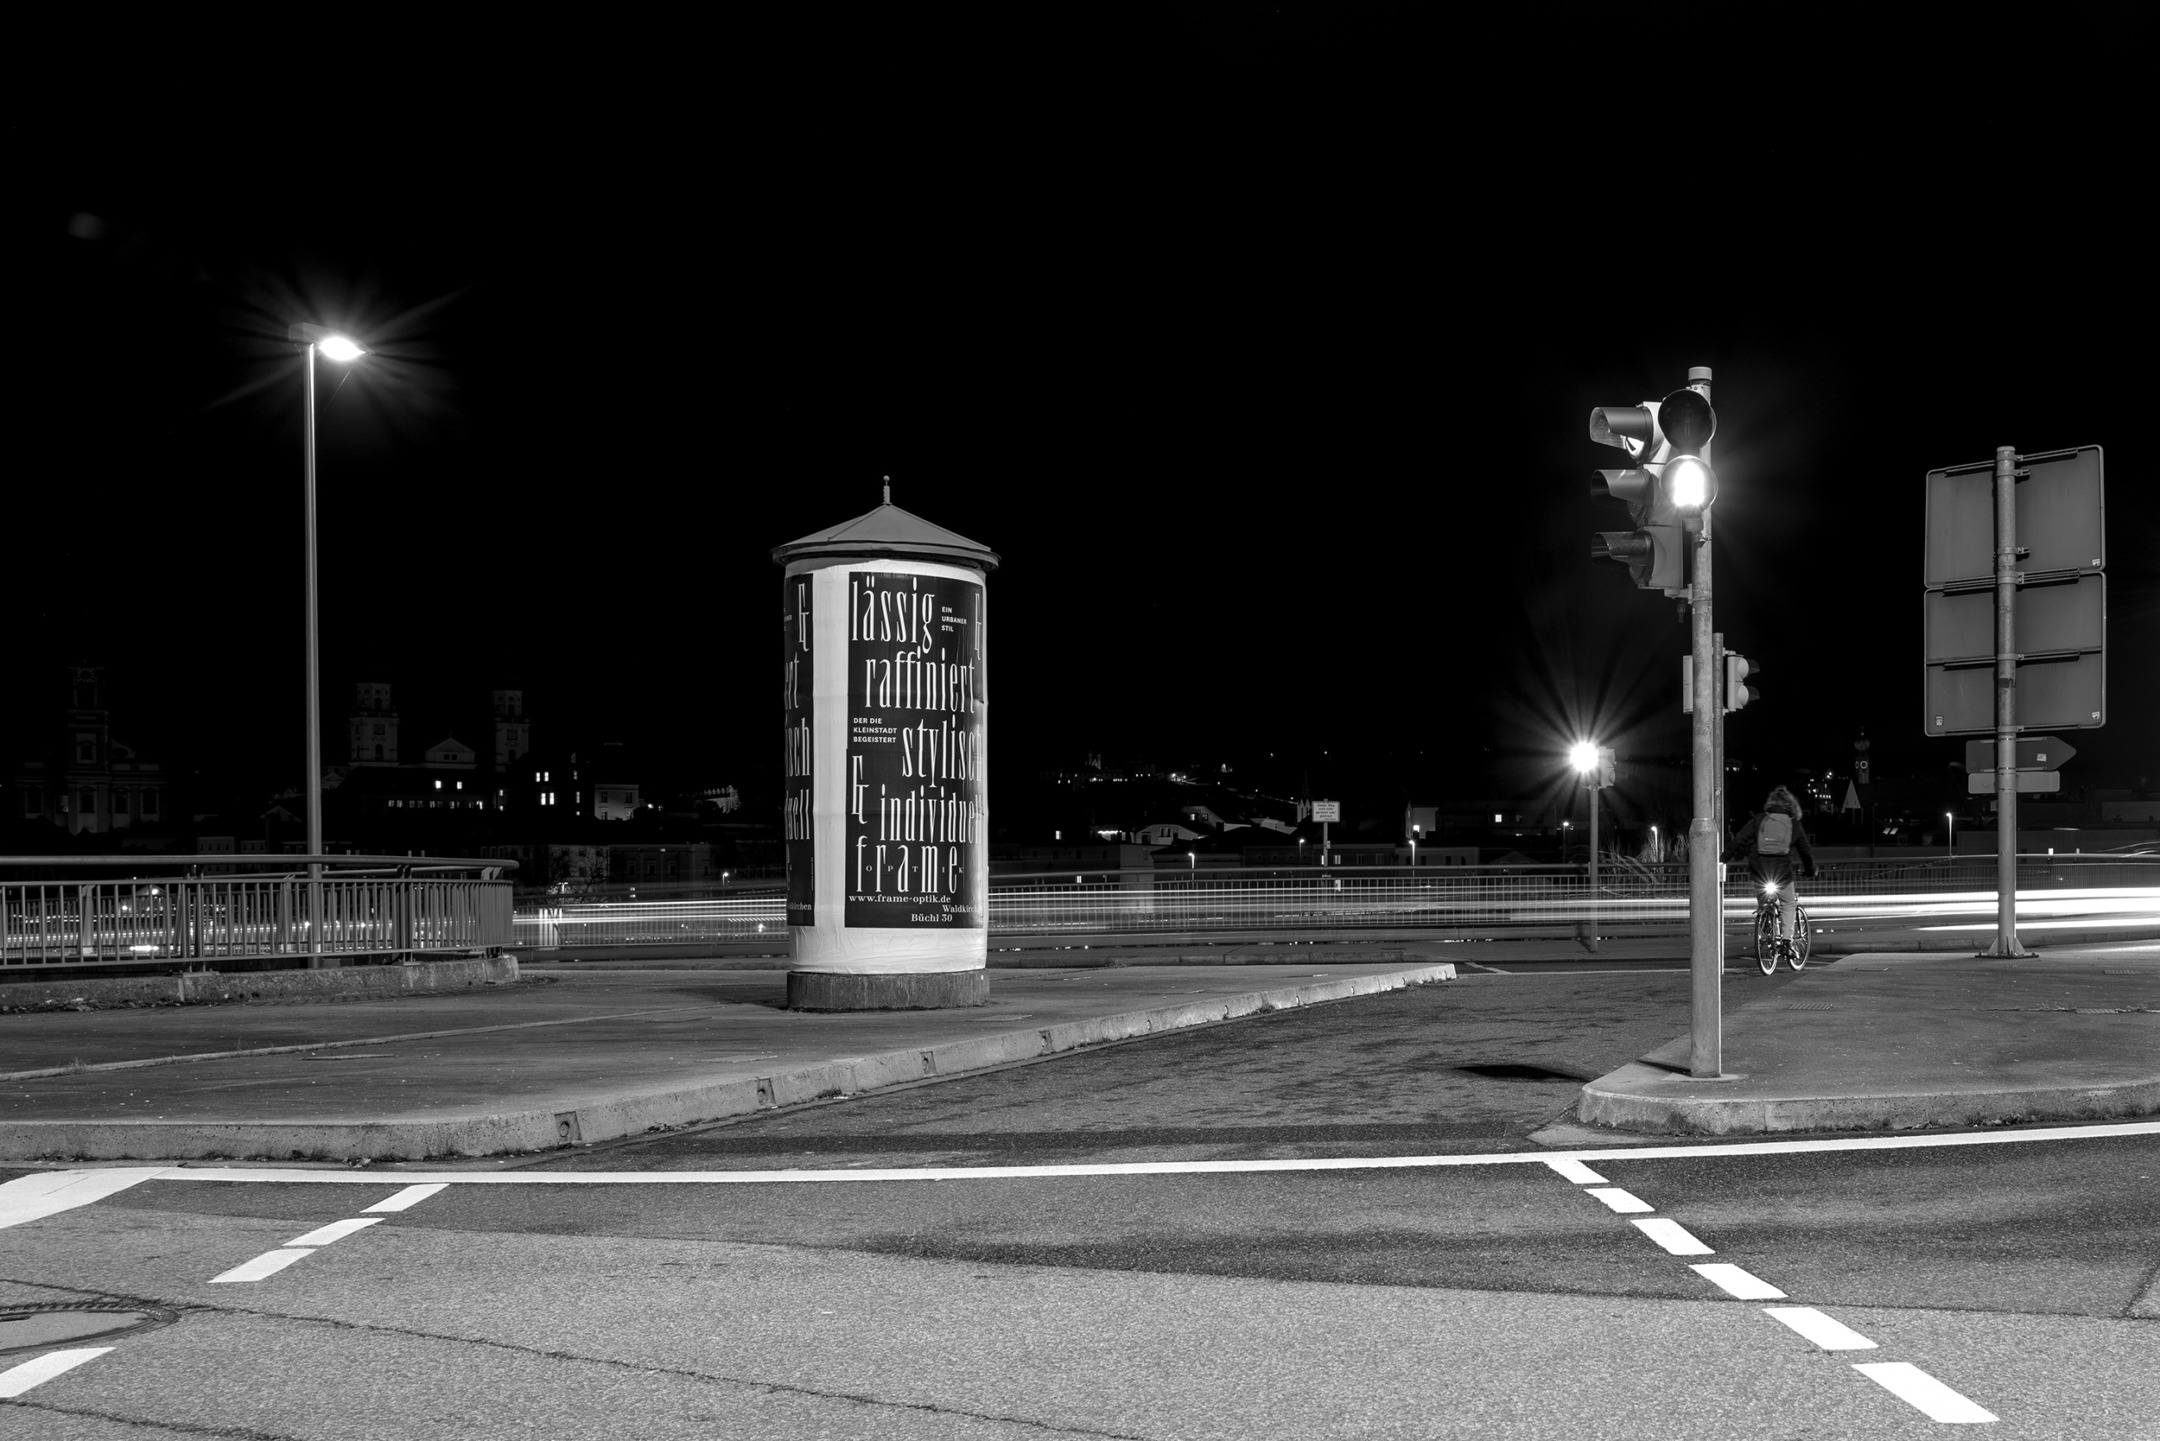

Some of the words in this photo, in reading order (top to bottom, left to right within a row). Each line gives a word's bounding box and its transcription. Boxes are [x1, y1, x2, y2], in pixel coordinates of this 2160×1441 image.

[851, 575, 936, 654] lässig
[941, 606, 953, 614] EIN
[941, 615, 968, 625] URBANER
[941, 624, 954, 633] STIL
[865, 645, 976, 714] raffiniert
[869, 717, 883, 725] DIE
[853, 726, 898, 734] KLEINSTADT
[853, 735, 897, 743] BEGEISTERT
[902, 714, 982, 788] stylisch
[880, 783, 982, 844] individuell
[856, 835, 959, 894] frame
[848, 893, 952, 905] www.frame-optik.de
[911, 913, 940, 922] Büchl
[941, 914, 953, 923] 30
